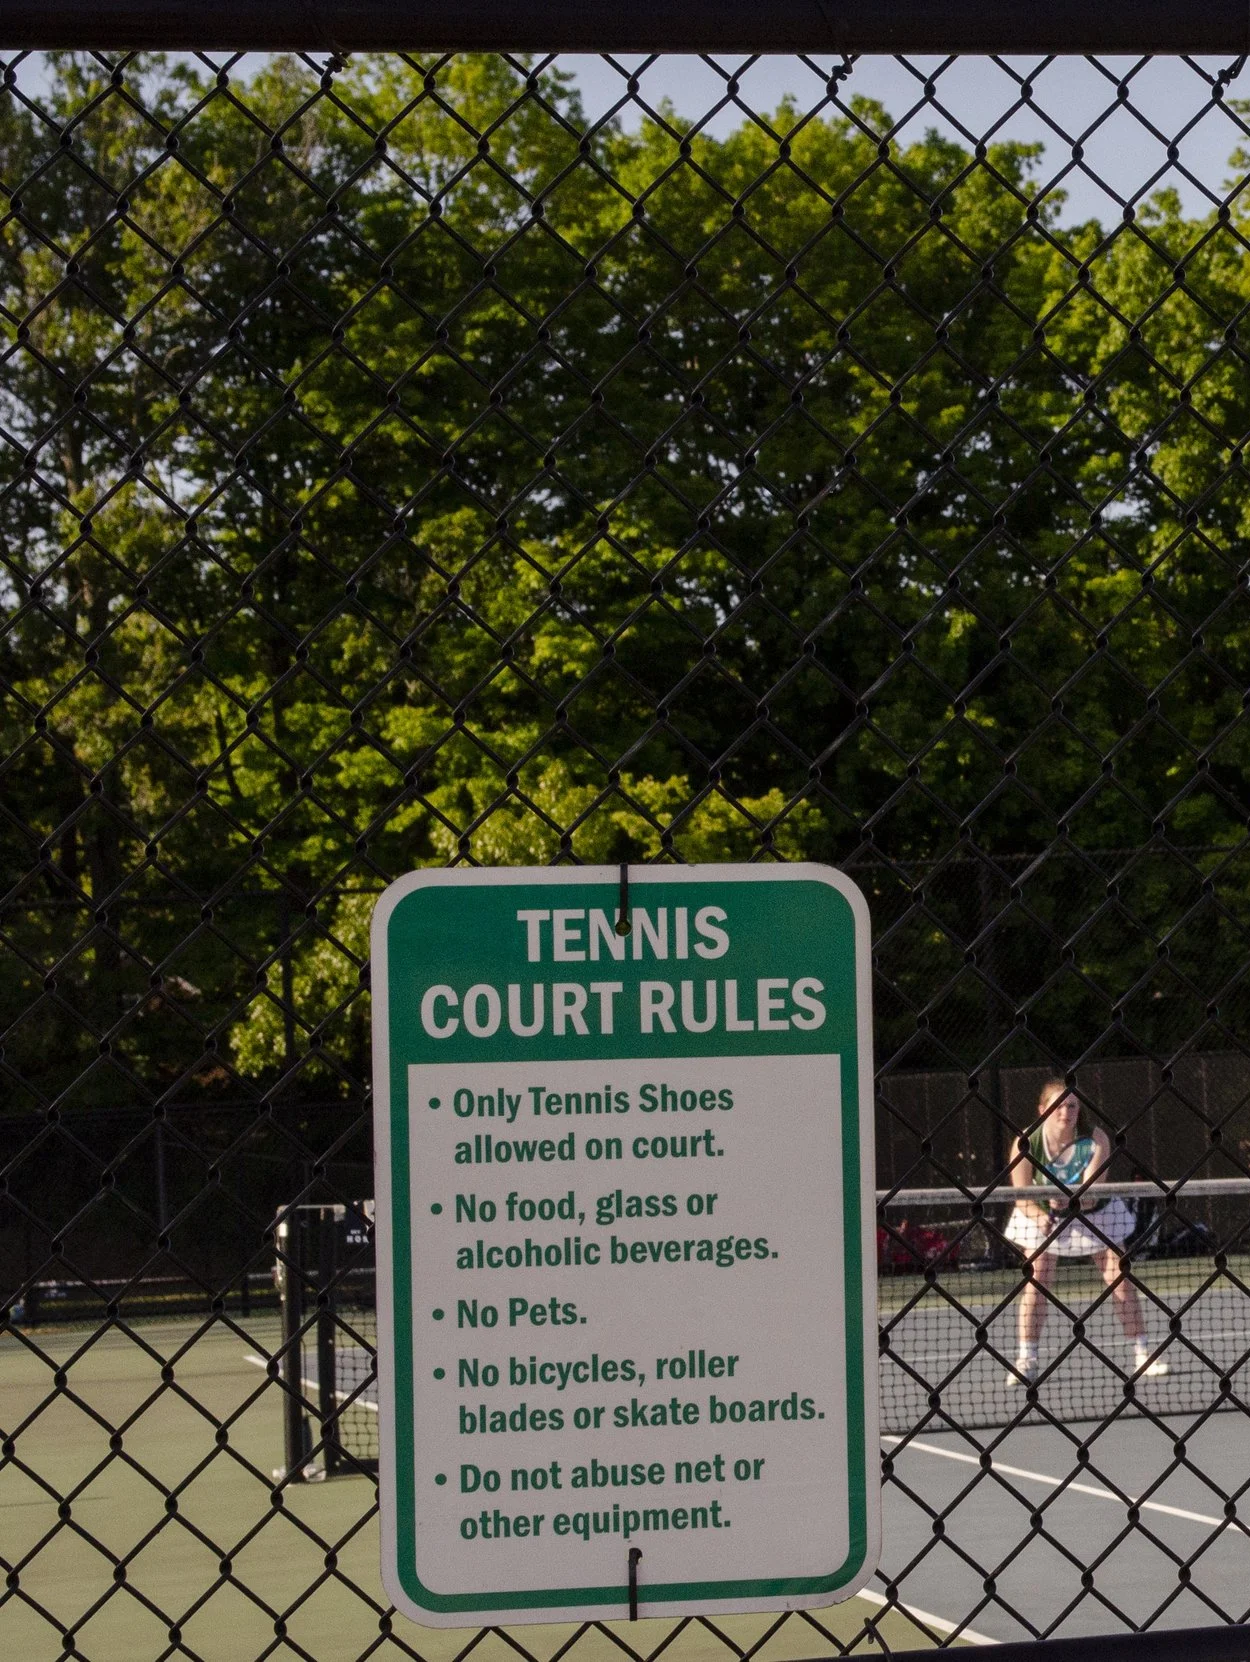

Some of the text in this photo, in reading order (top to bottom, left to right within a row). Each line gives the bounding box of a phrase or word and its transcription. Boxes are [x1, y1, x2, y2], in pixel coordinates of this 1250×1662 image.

[517, 906, 729, 962] TENNIS
[421, 977, 826, 1038] COURT RULES
[454, 1084, 733, 1123] Only Tennis Shoes
[455, 1129, 723, 1164] allowed on court.
[456, 1189, 718, 1226] No food, glass or
[457, 1236, 778, 1269] alcoholic beverages.
[458, 1298, 586, 1328] No Pets.
[459, 1349, 739, 1391] No bicycles, roller
[460, 1392, 824, 1434] blades or skate boards.
[461, 1455, 765, 1493] Do not abuse net or
[460, 1501, 730, 1539] other equipment.
